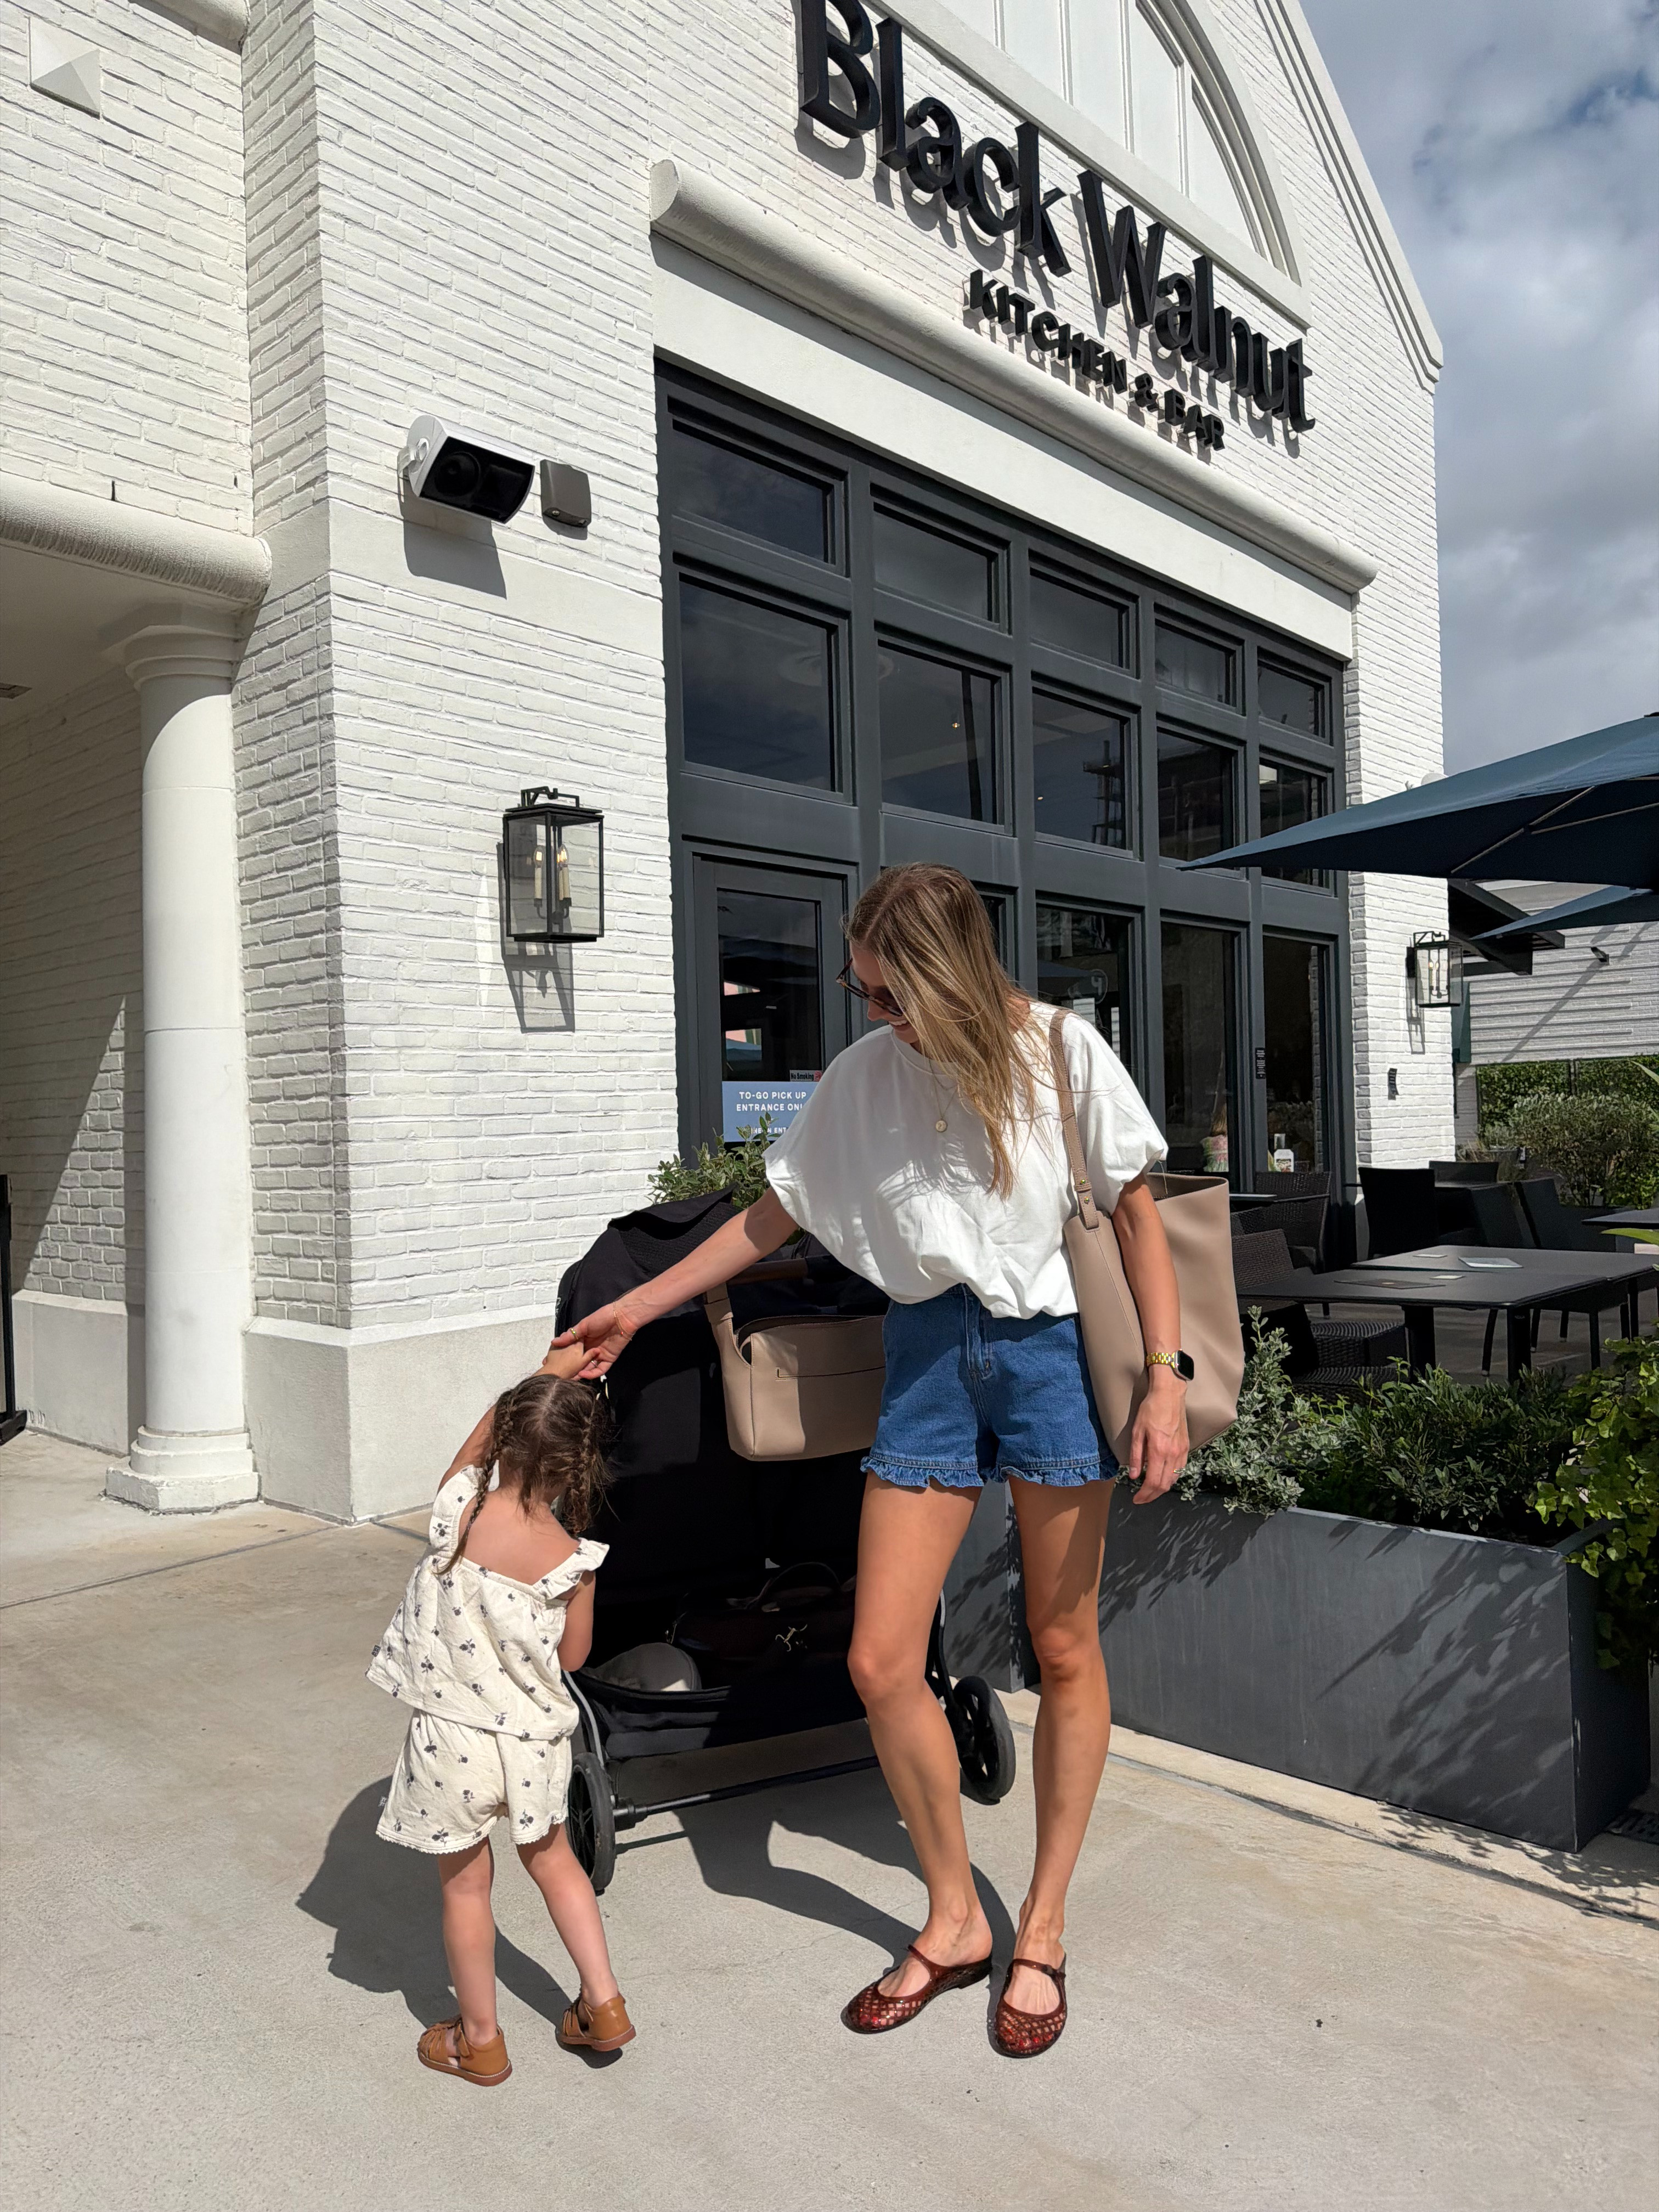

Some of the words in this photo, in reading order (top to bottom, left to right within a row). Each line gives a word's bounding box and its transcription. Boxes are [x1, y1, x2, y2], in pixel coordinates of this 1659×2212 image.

[800, 0, 1071, 277] Black
[1077, 170, 1316, 433] Walnut
[969, 269, 1127, 394] KITCHEN
[1134, 373, 1159, 412] &
[1164, 389, 1225, 450] BAR
[736, 1103, 785, 1111] ENTRANCE
[739, 1091, 769, 1099] TO-GO
[771, 1091, 792, 1099] PICK
[795, 1091, 806, 1099] UP
